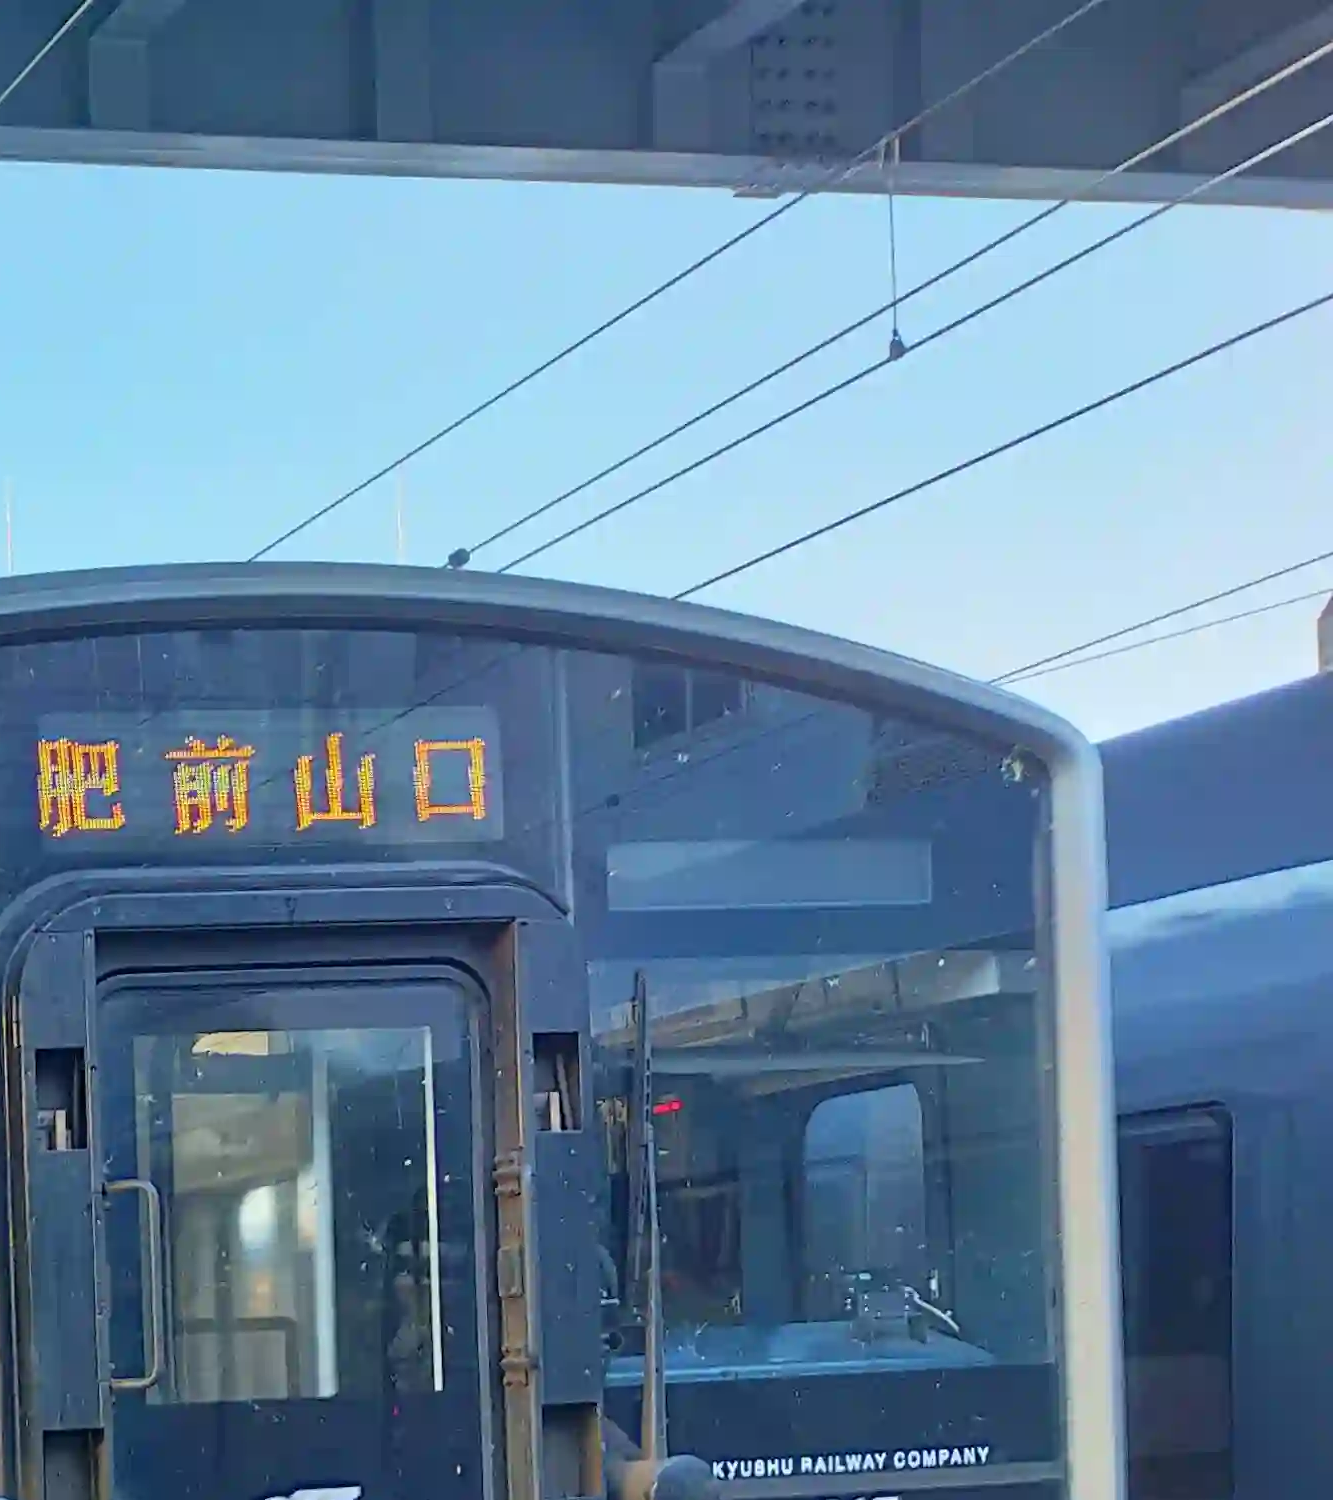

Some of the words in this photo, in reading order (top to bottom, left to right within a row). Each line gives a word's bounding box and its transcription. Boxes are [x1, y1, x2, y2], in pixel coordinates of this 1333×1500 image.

[36, 731, 487, 837] 肥前山口
[711, 1457, 794, 1480] KYUSHU
[800, 1451, 887, 1475] RAILWAY
[893, 1445, 991, 1469] COMPANY
